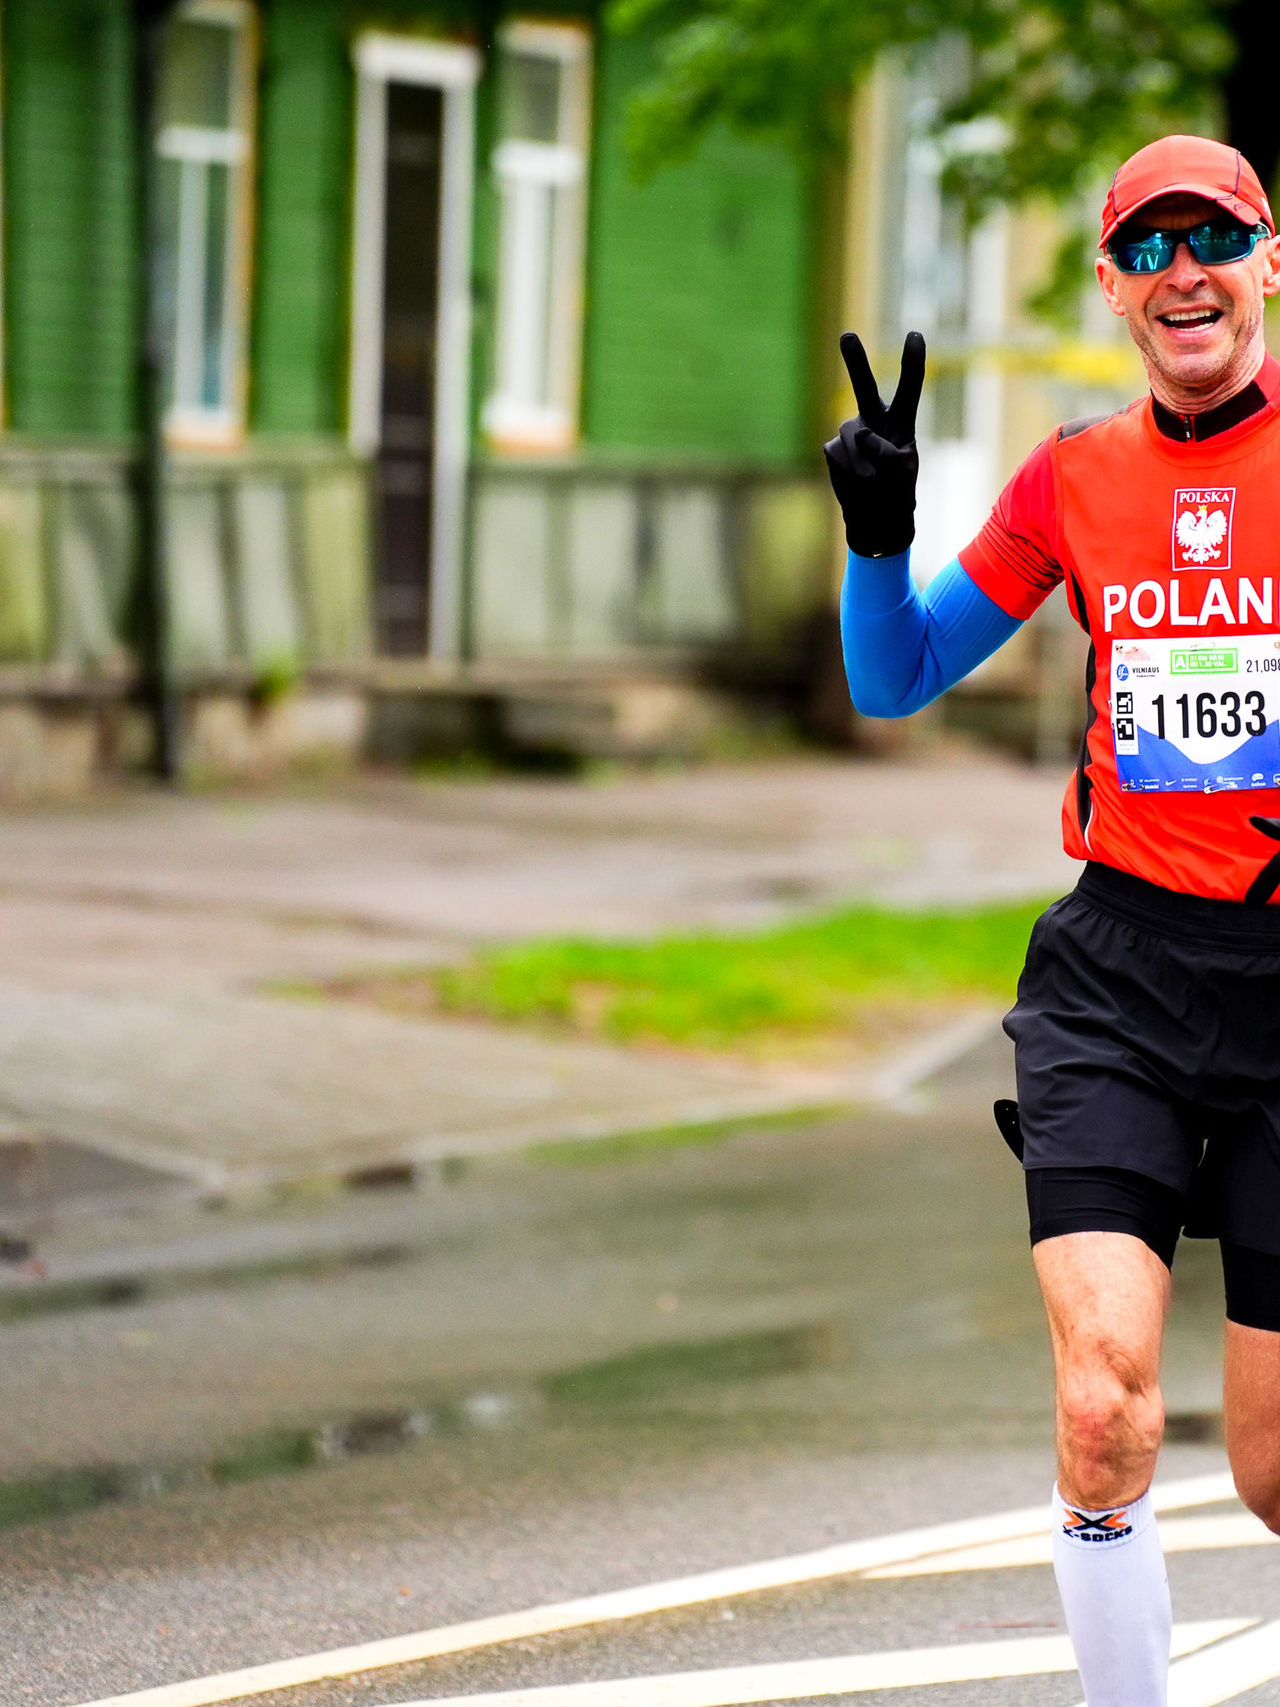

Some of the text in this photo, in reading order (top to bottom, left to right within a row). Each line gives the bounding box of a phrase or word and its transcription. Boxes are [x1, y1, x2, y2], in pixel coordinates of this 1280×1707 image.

[1179, 491, 1230, 503] POLSKA
[1175, 654, 1186, 669] A
[1132, 666, 1160, 674] VILNIAUS
[1151, 690, 1267, 740] 11633
[1062, 1524, 1133, 1542] X-SOCKS
